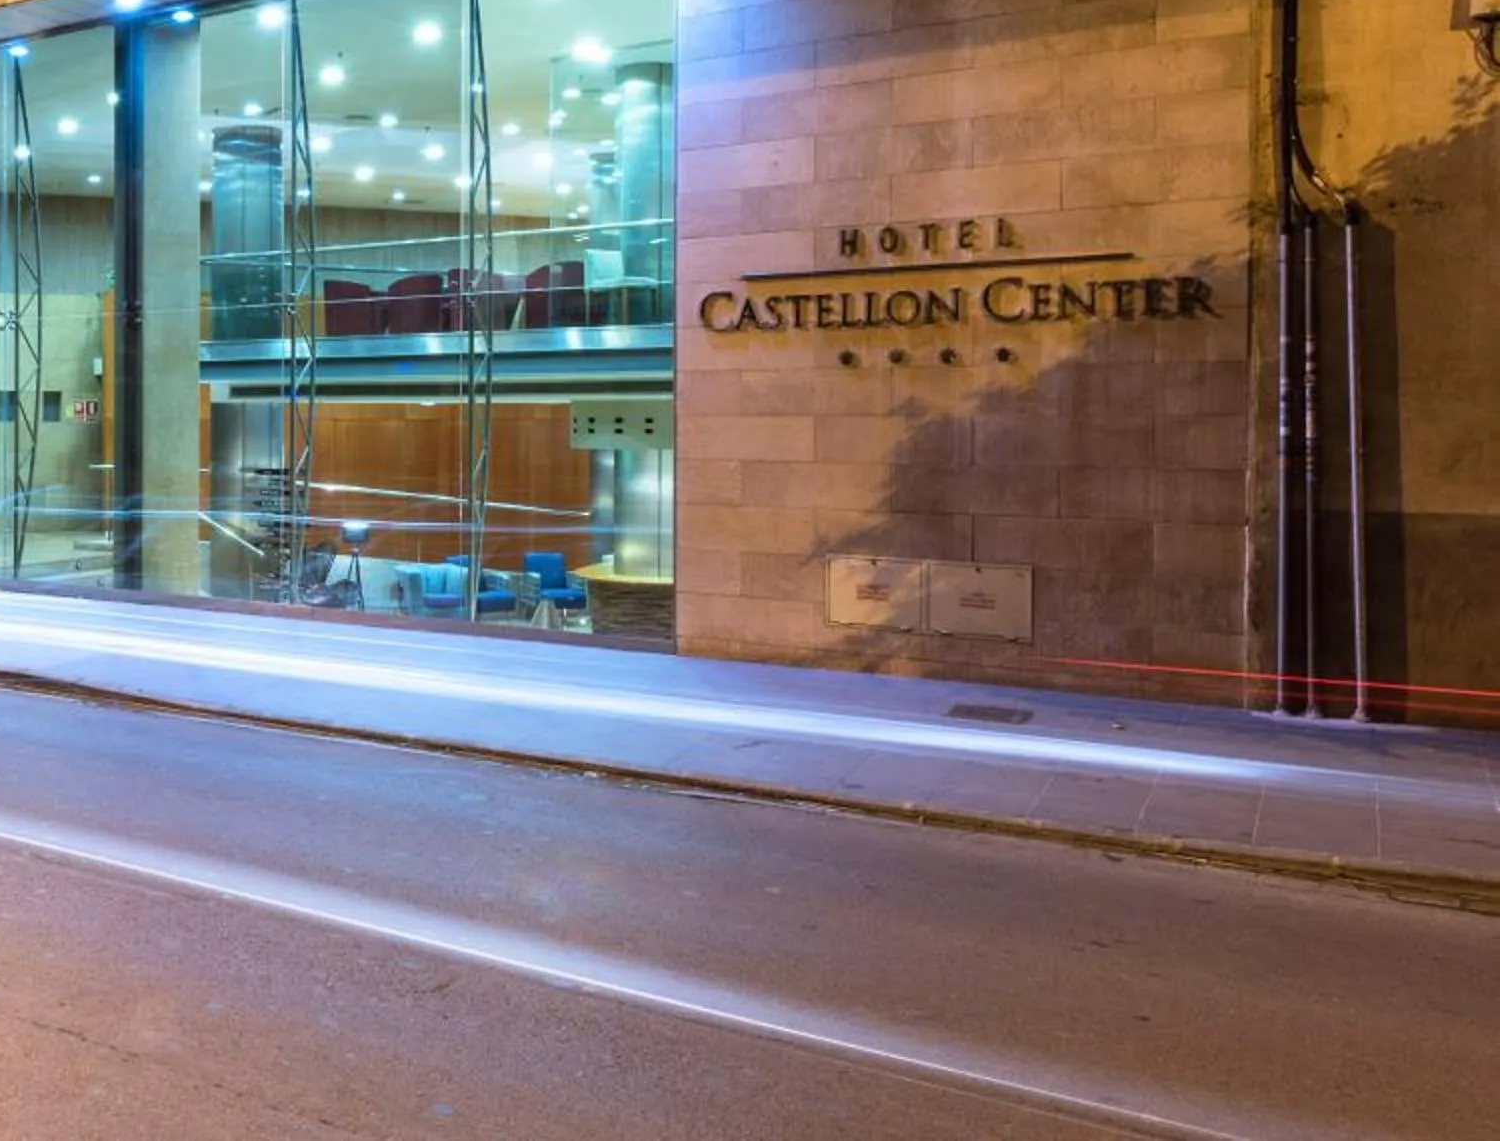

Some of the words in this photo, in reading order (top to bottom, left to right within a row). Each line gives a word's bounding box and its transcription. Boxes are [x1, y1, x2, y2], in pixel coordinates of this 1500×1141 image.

[838, 218, 1016, 256] HOTEL
[699, 287, 963, 332] CASTELLON
[982, 275, 1222, 323] CENTER
